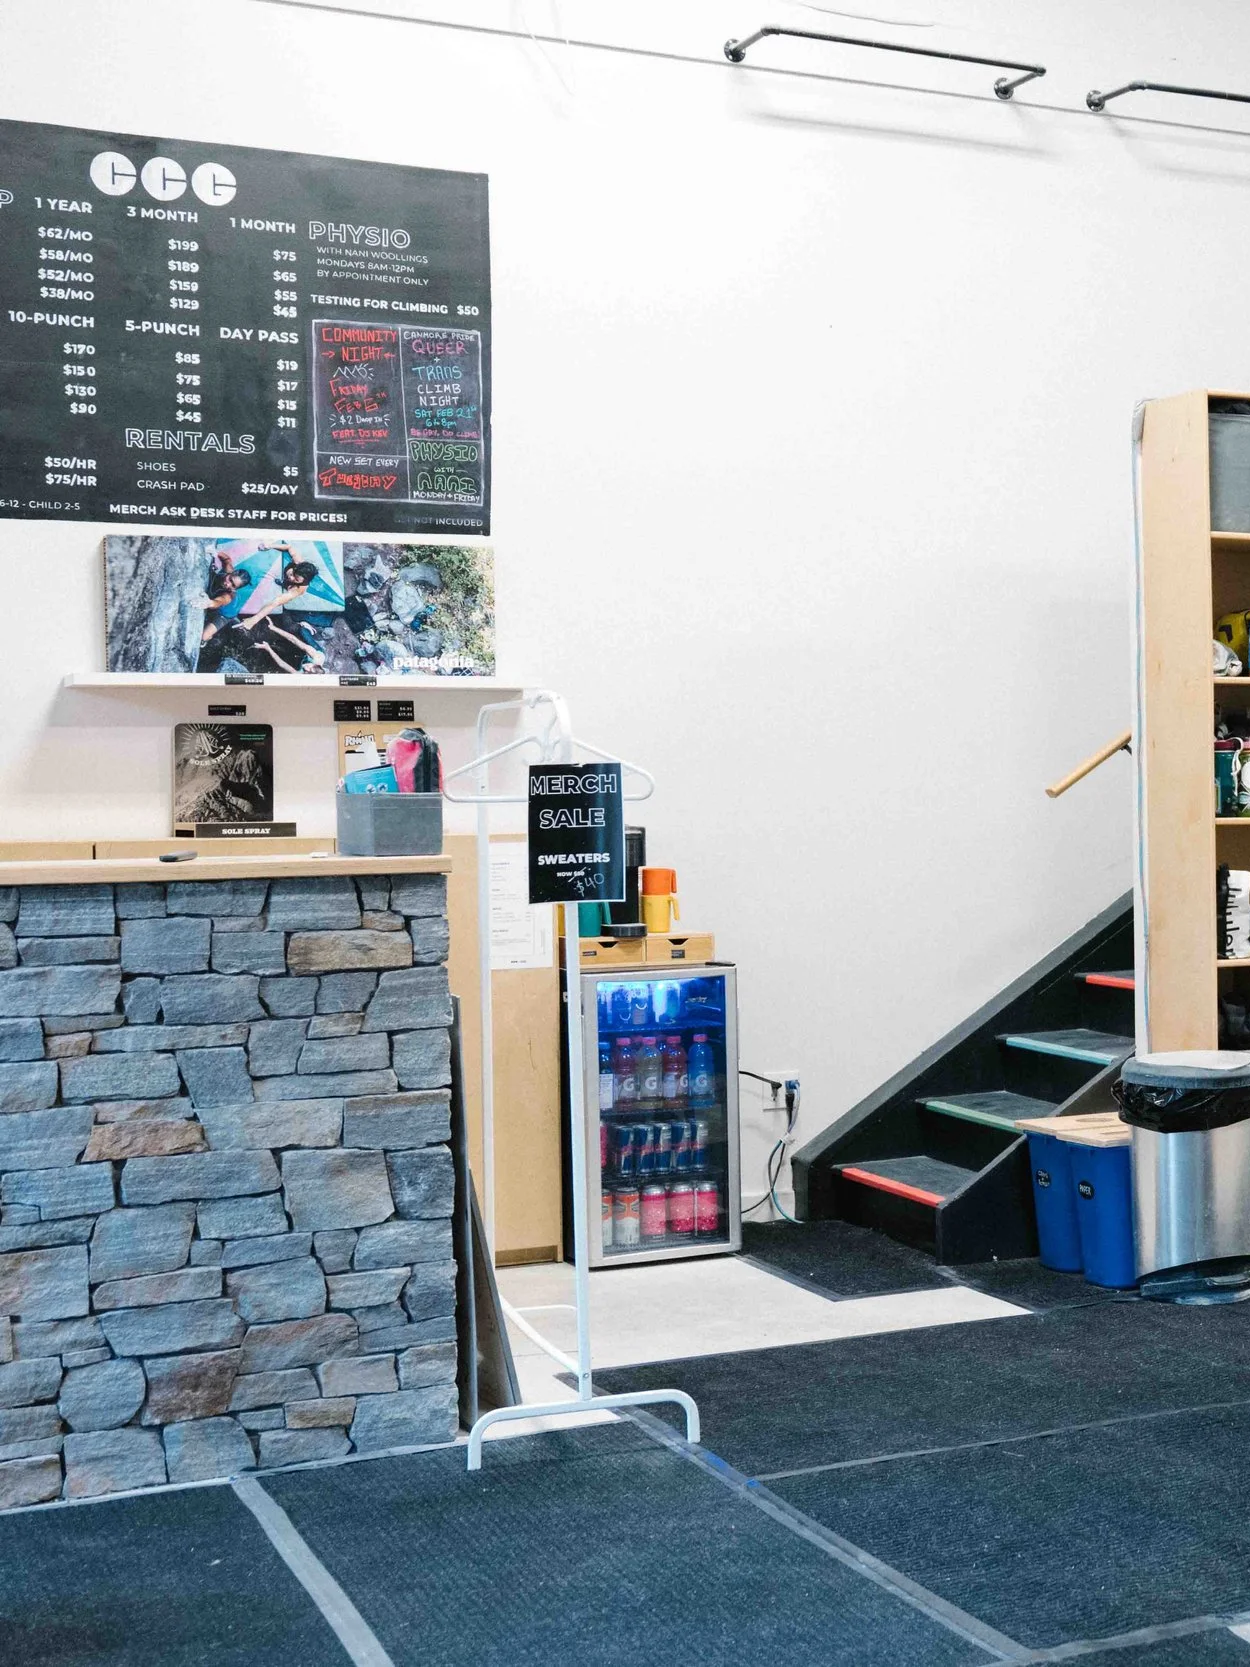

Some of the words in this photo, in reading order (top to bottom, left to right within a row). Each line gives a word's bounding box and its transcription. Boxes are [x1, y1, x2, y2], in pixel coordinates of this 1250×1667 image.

[34, 196, 42, 208] 1
[47, 198, 93, 213] YEAR
[127, 206, 136, 217] 3
[141, 208, 198, 222] MONTH
[229, 217, 236, 228] 1
[241, 218, 296, 233] MONTH
[37, 226, 93, 241] $62/MO
[308, 220, 411, 249] PHYSIO
[168, 239, 199, 252] $199
[39, 247, 94, 263] $58/MO
[273, 249, 297, 261] $75
[316, 246, 342, 255] WITH
[345, 249, 369, 258] NANI
[371, 250, 428, 264] WOOLLINGS
[168, 260, 199, 273] $189
[316, 258, 365, 269] MONDAYS
[367, 262, 415, 273] 8AM-12PM
[37, 268, 94, 283] $52/MO
[273, 270, 297, 282] $65
[316, 269, 330, 278] BY
[332, 271, 401, 284] APPOINTMENT
[403, 277, 429, 286] ONLY
[169, 279, 199, 292] $159
[40, 286, 94, 301] $38/MO
[274, 289, 298, 302] $55
[169, 297, 199, 310] $129
[310, 294, 361, 307] TESTING
[363, 298, 388, 310] FOR
[391, 300, 449, 314] CLIMBING
[456, 304, 479, 316] $50
[273, 304, 298, 318] $45
[8, 310, 95, 328] 10-PUNCH
[125, 320, 200, 336] 5-PUNCH
[322, 327, 397, 343] COMMUNITY
[219, 327, 254, 341] DAY
[258, 330, 299, 344] PASS
[403, 331, 447, 340] CANMORE
[451, 333, 476, 342] PRIDE
[63, 342, 96, 355] $170
[342, 346, 384, 362] NIGHT
[412, 340, 469, 355] QUEER
[175, 351, 201, 365] $85
[276, 359, 298, 371] $19
[63, 364, 96, 376] $150
[412, 365, 462, 381] TRANS
[176, 372, 200, 386] $75
[277, 379, 298, 392] $17
[64, 383, 97, 396] $130
[417, 383, 461, 394] CLIMB
[176, 392, 201, 405] $65
[277, 399, 297, 411] $15
[419, 395, 459, 407] NIGHT
[70, 402, 97, 414] $90
[415, 408, 432, 418] SAT
[437, 408, 454, 417] FEB
[175, 409, 201, 423] $45
[277, 416, 296, 428] $11
[340, 414, 353, 425] $2
[125, 428, 256, 454] RENTALS
[409, 440, 478, 462] PHYSIO
[44, 456, 97, 470] $50/HR
[137, 461, 177, 472] SHOES
[329, 456, 352, 465] NEW
[354, 456, 373, 466] SET
[375, 458, 399, 468] EVERY
[283, 465, 299, 477] $5
[434, 466, 455, 474] WITH
[45, 472, 97, 487] $75/HR
[137, 479, 177, 490] CRASH
[180, 481, 205, 492] PAD
[241, 481, 299, 495] $25/DAY
[412, 490, 447, 499] MONDAY
[453, 493, 480, 503] FRIDAY
[28, 500, 62, 510] CHILD
[64, 502, 80, 511] 2-5
[109, 503, 157, 516] MERCH
[160, 505, 186, 517] ASK
[190, 506, 224, 519] DESK
[228, 508, 267, 520] STAFF
[270, 510, 296, 521] FOR
[299, 511, 347, 523] PRICES!
[435, 517, 483, 527] INCLUDED
[530, 773, 617, 796] MERCH
[539, 808, 606, 829] SALE
[244, 827, 271, 835] SPRAY
[537, 852, 611, 866] SWEATERS
[576, 872, 605, 898] $40
[623, 1078, 635, 1091] G
[644, 1076, 657, 1090] G
